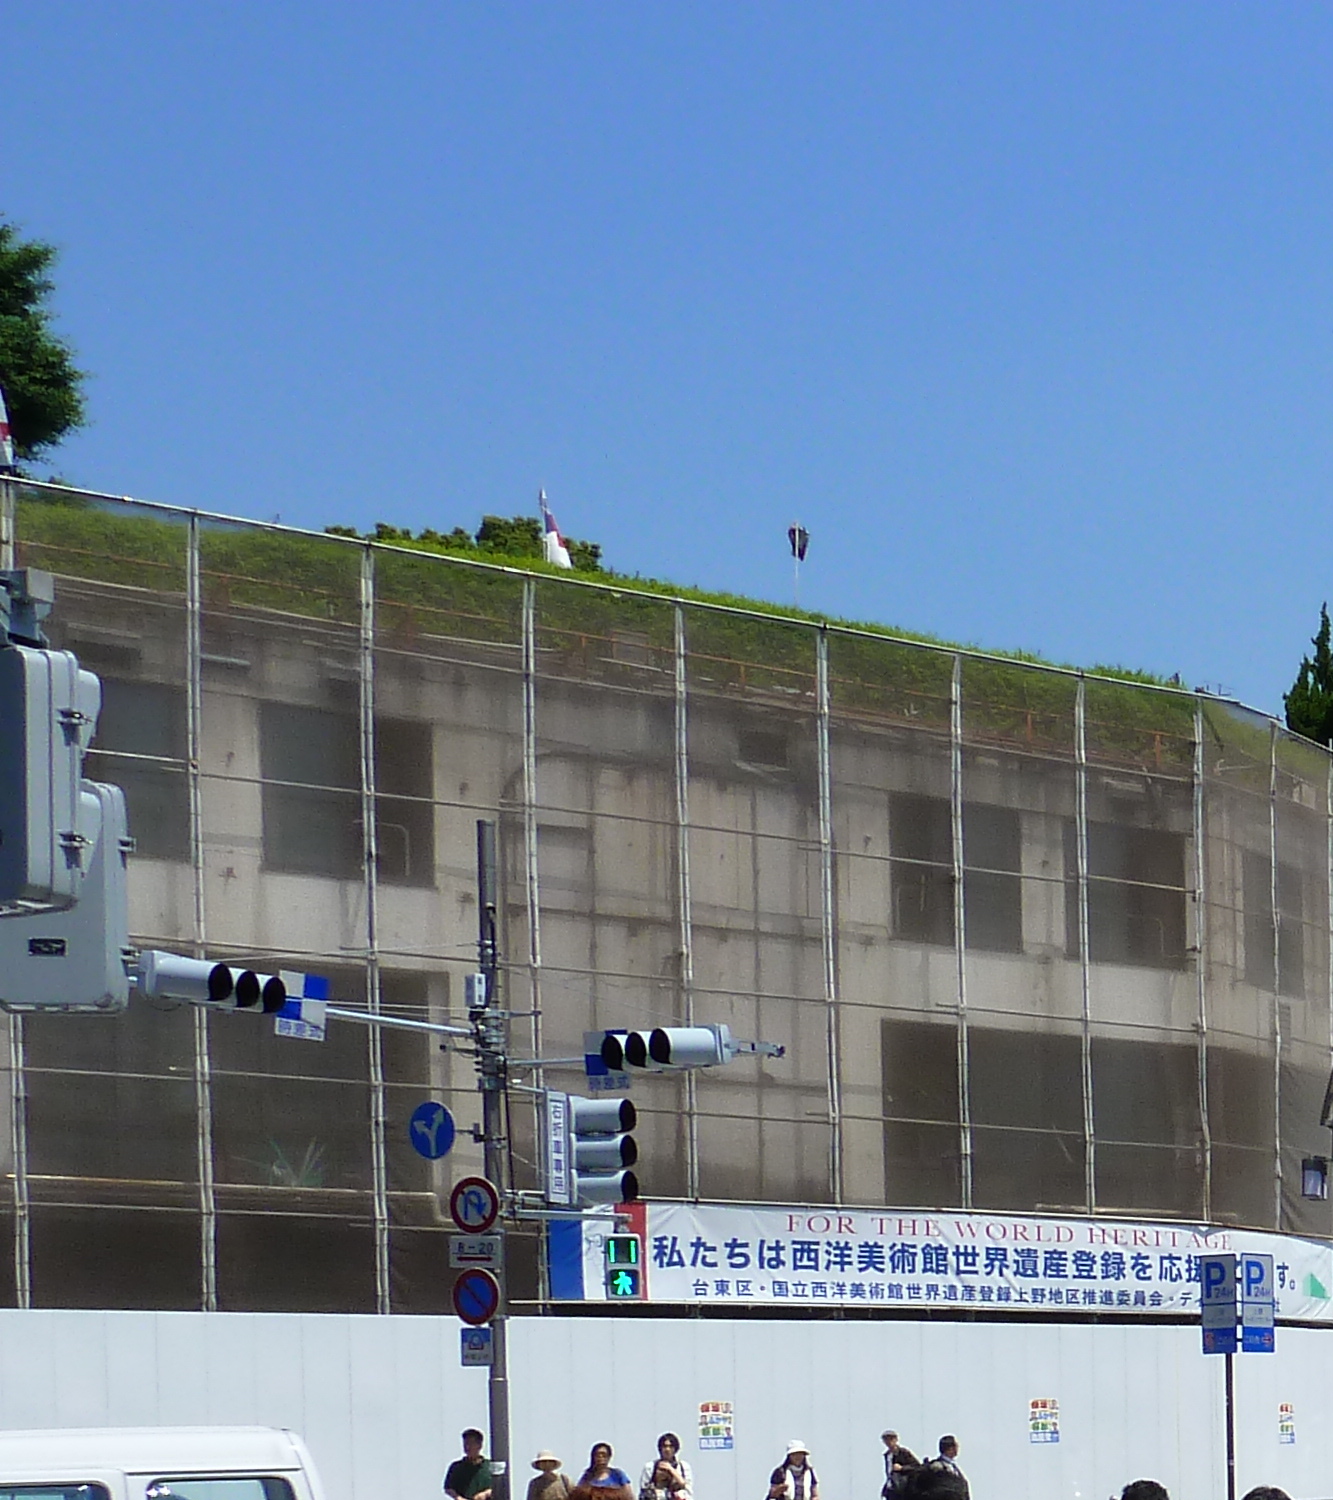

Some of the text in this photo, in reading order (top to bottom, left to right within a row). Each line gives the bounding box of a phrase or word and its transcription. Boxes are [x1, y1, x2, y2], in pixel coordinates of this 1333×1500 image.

[786, 1213, 1233, 1251] FOR THE WORLD HERITAGE
[1205, 1261, 1226, 1299] P
[1245, 1260, 1265, 1297] P
